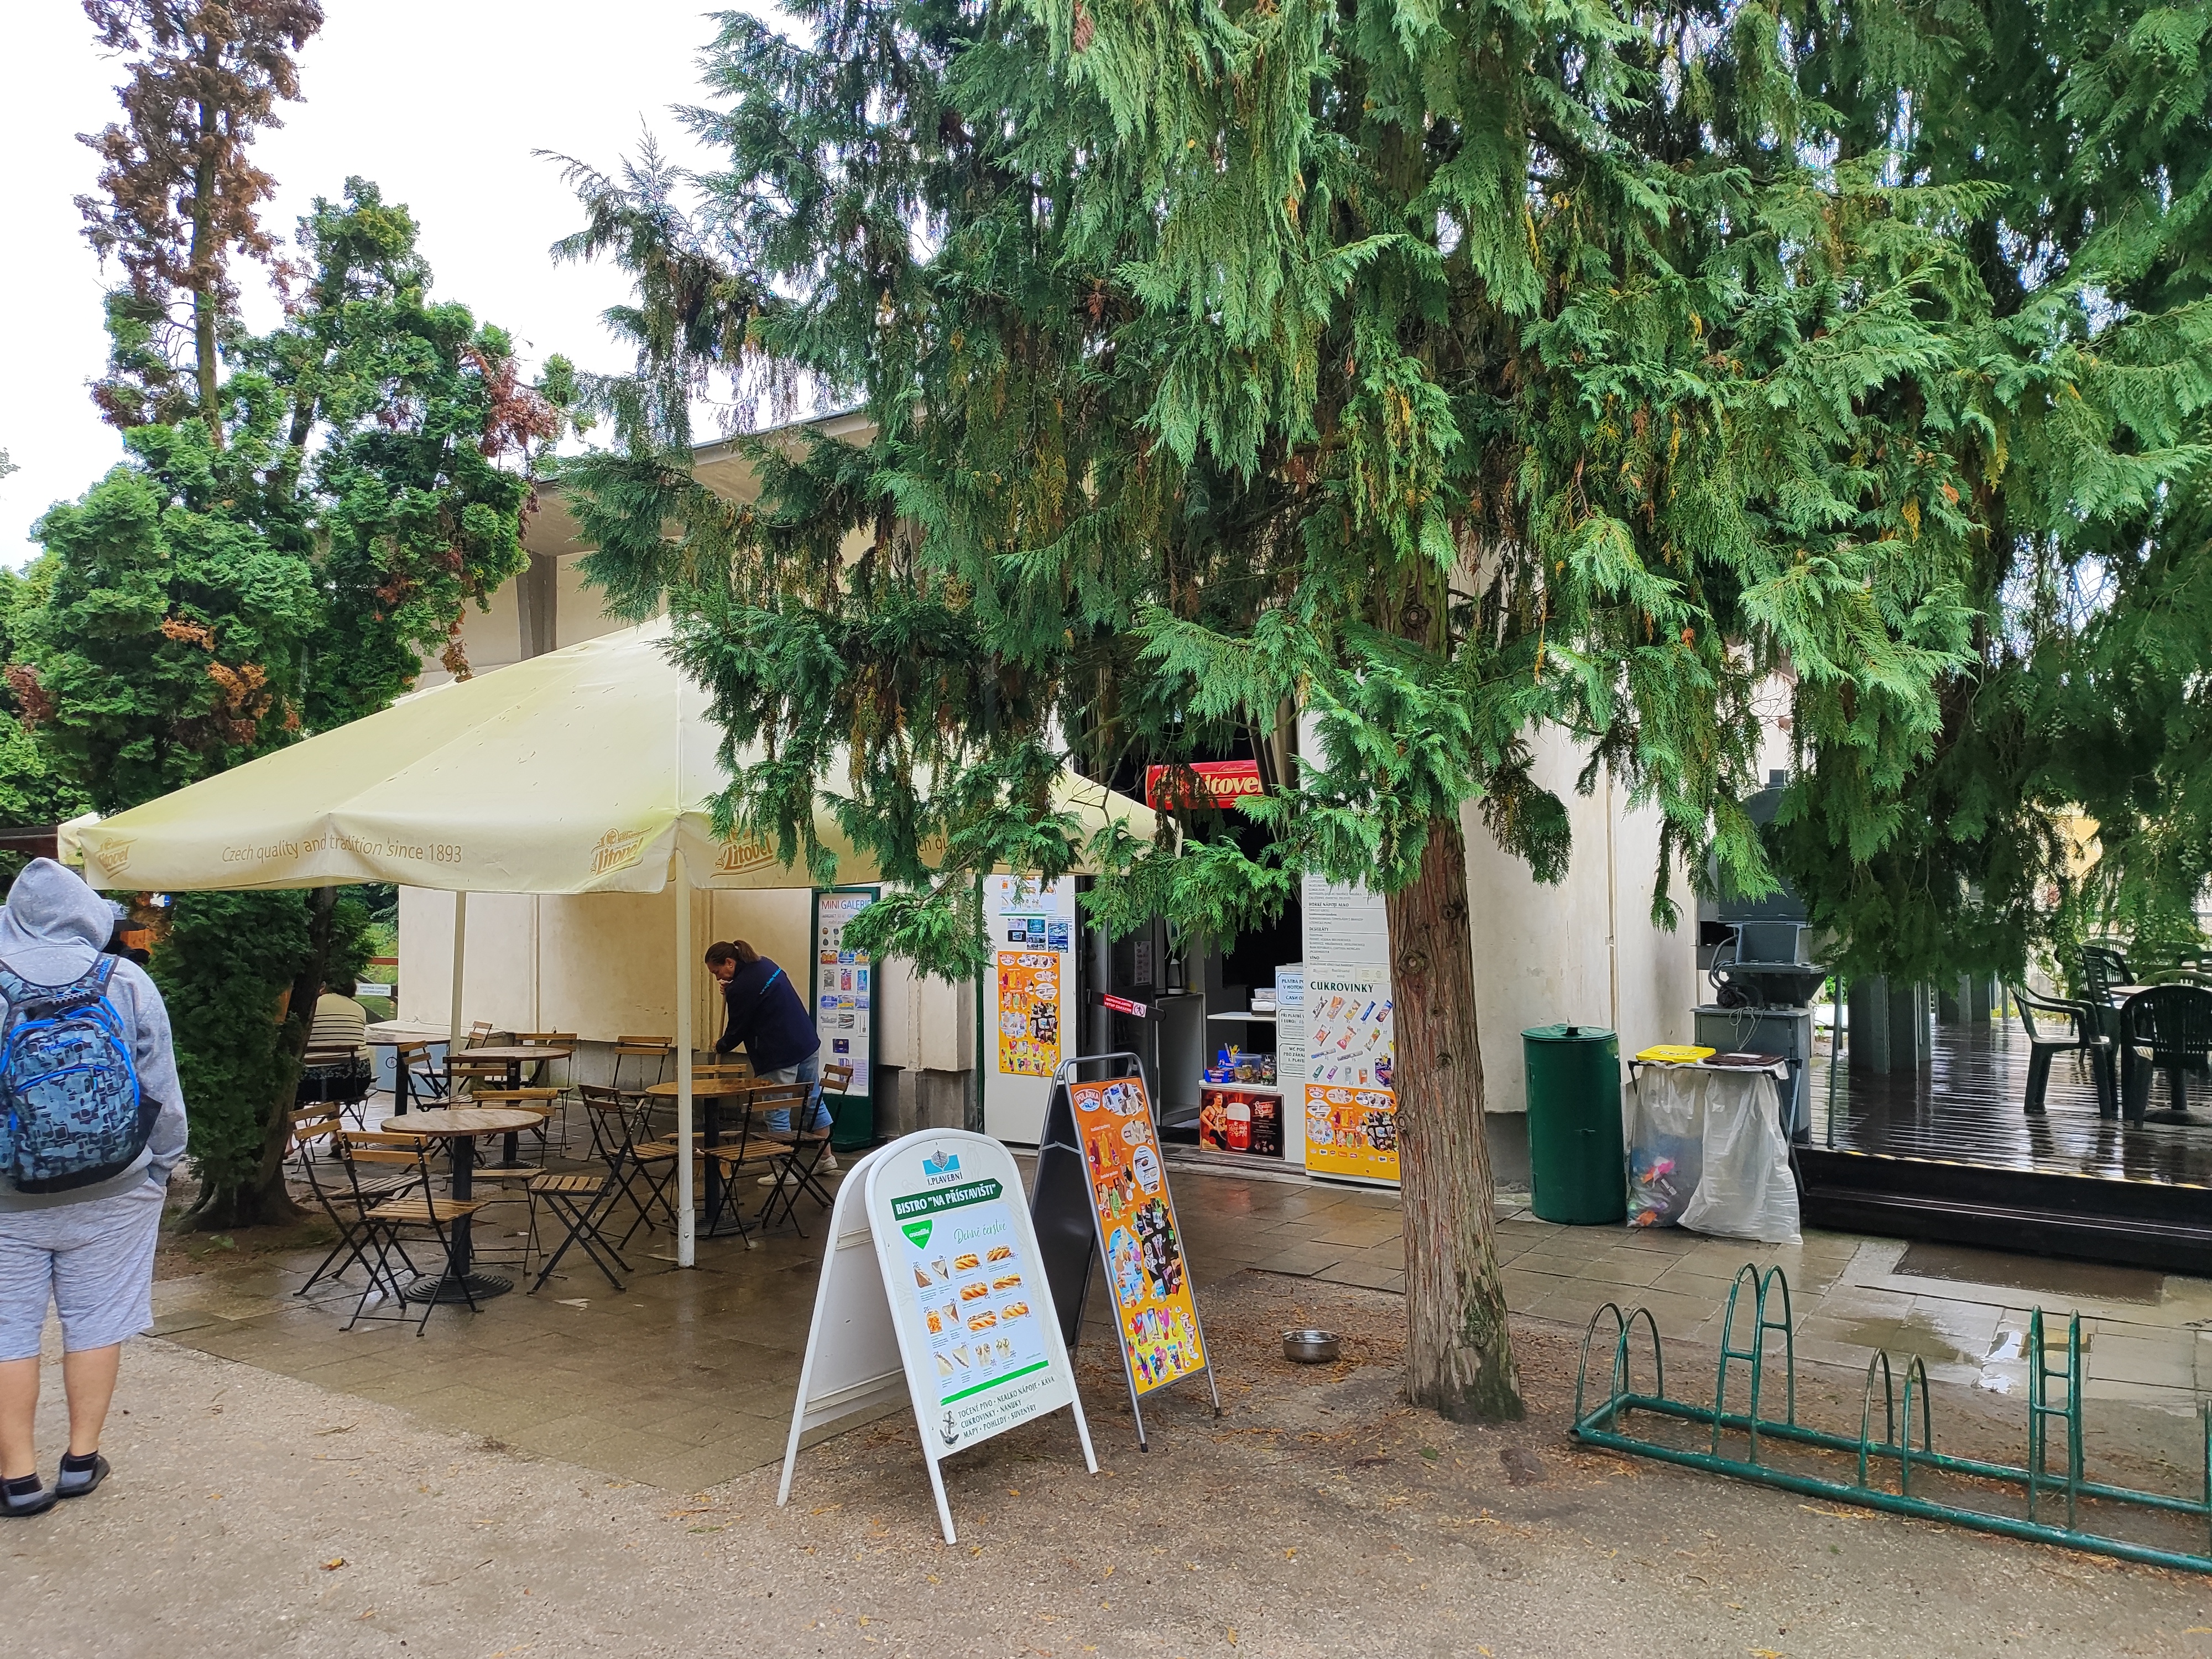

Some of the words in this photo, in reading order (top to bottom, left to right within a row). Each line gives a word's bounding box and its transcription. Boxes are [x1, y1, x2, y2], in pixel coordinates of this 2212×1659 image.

[1194, 775, 1264, 795] itove
[222, 844, 253, 863] Czech
[257, 840, 299, 863] quality
[303, 833, 326, 853] and
[330, 834, 383, 856] tradition
[387, 839, 424, 860] since
[429, 843, 462, 863] 1893
[596, 837, 644, 875] Litovel
[723, 836, 773, 870] Litovel
[822, 900, 839, 910] MINI
[1310, 981, 1374, 993] CUKROVINKY
[1076, 1091, 1099, 1103] POLÁRKA
[895, 1199, 927, 1215] BISTRO
[954, 1227, 980, 1244] Denně
[983, 1219, 1007, 1235] čerstvé
[958, 1403, 980, 1418] TOČENÉ
[980, 1400, 993, 1411] PIVO
[997, 1391, 1018, 1404] NEALKO
[1018, 1382, 1038, 1394] NÁPOJE
[1041, 1376, 1055, 1386] KÁVA
[961, 1409, 996, 1428] CUKROVINKY
[1000, 1399, 1022, 1413] NANUKY
[963, 1427, 979, 1439] MAPY
[983, 1416, 1007, 1431] POHLEDY
[1011, 1404, 1037, 1420] SUVENÝRY
